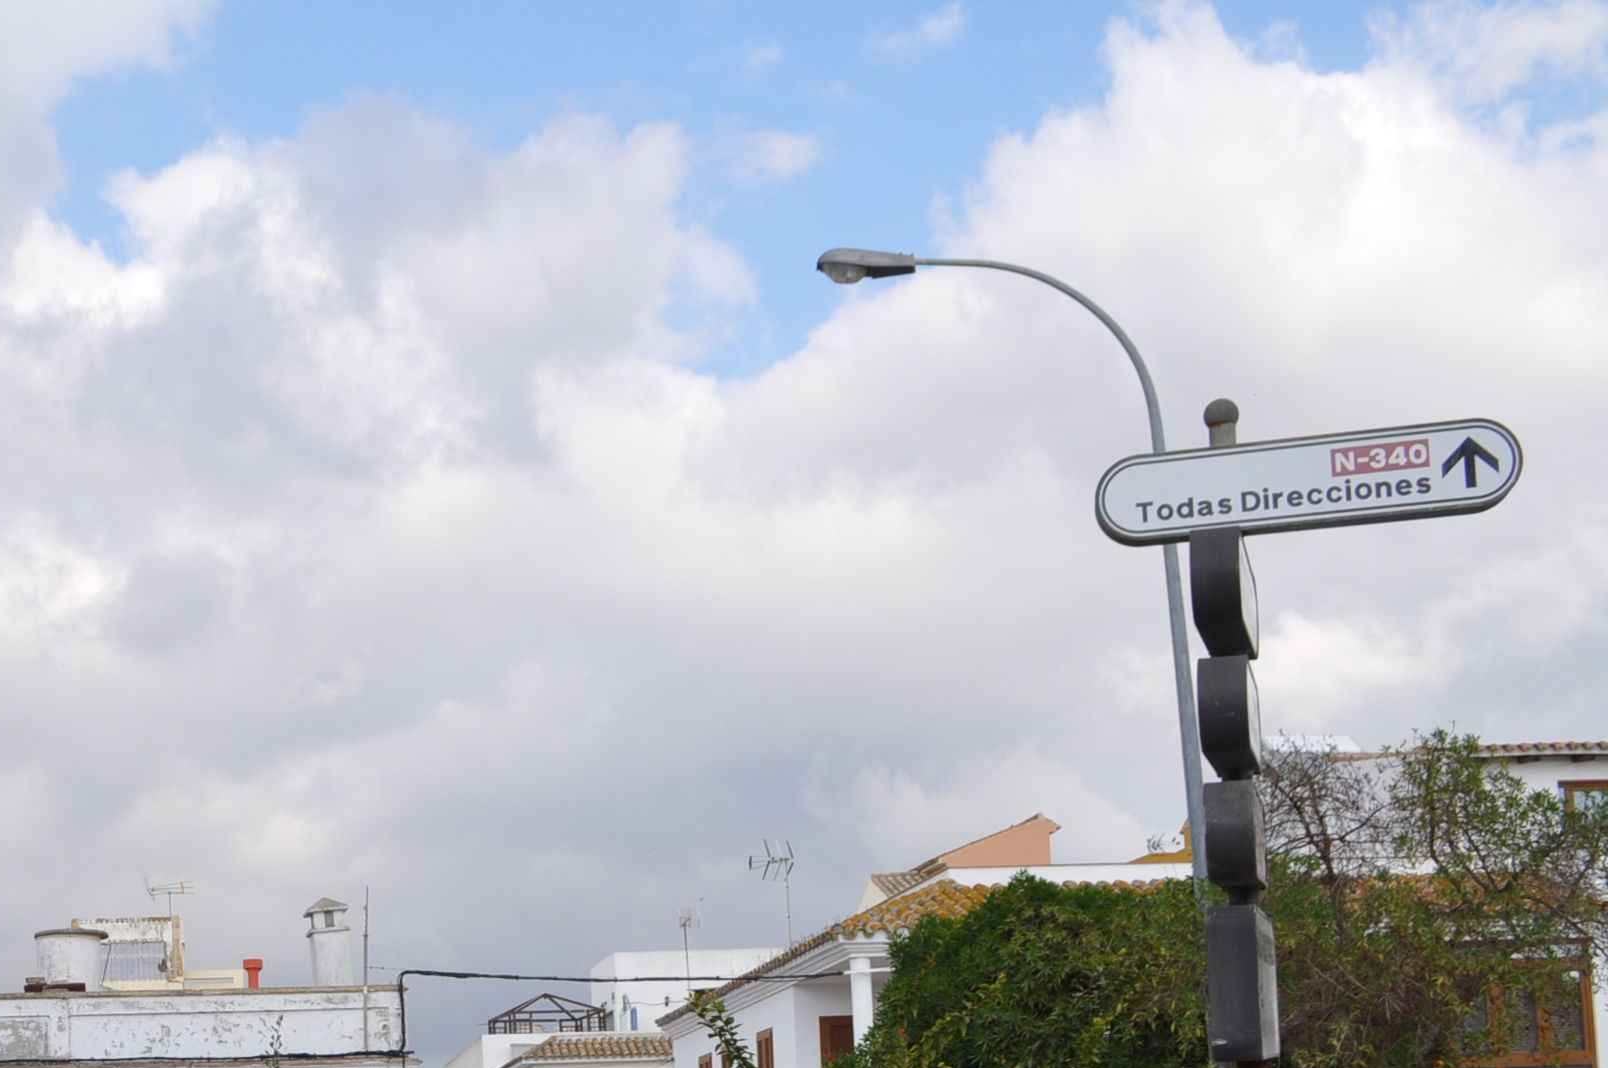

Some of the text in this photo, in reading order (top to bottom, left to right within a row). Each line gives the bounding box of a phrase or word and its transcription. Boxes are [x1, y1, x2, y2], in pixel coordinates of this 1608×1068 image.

[1334, 443, 1428, 473] N-340
[1135, 477, 1432, 523] Todas Direcciones
